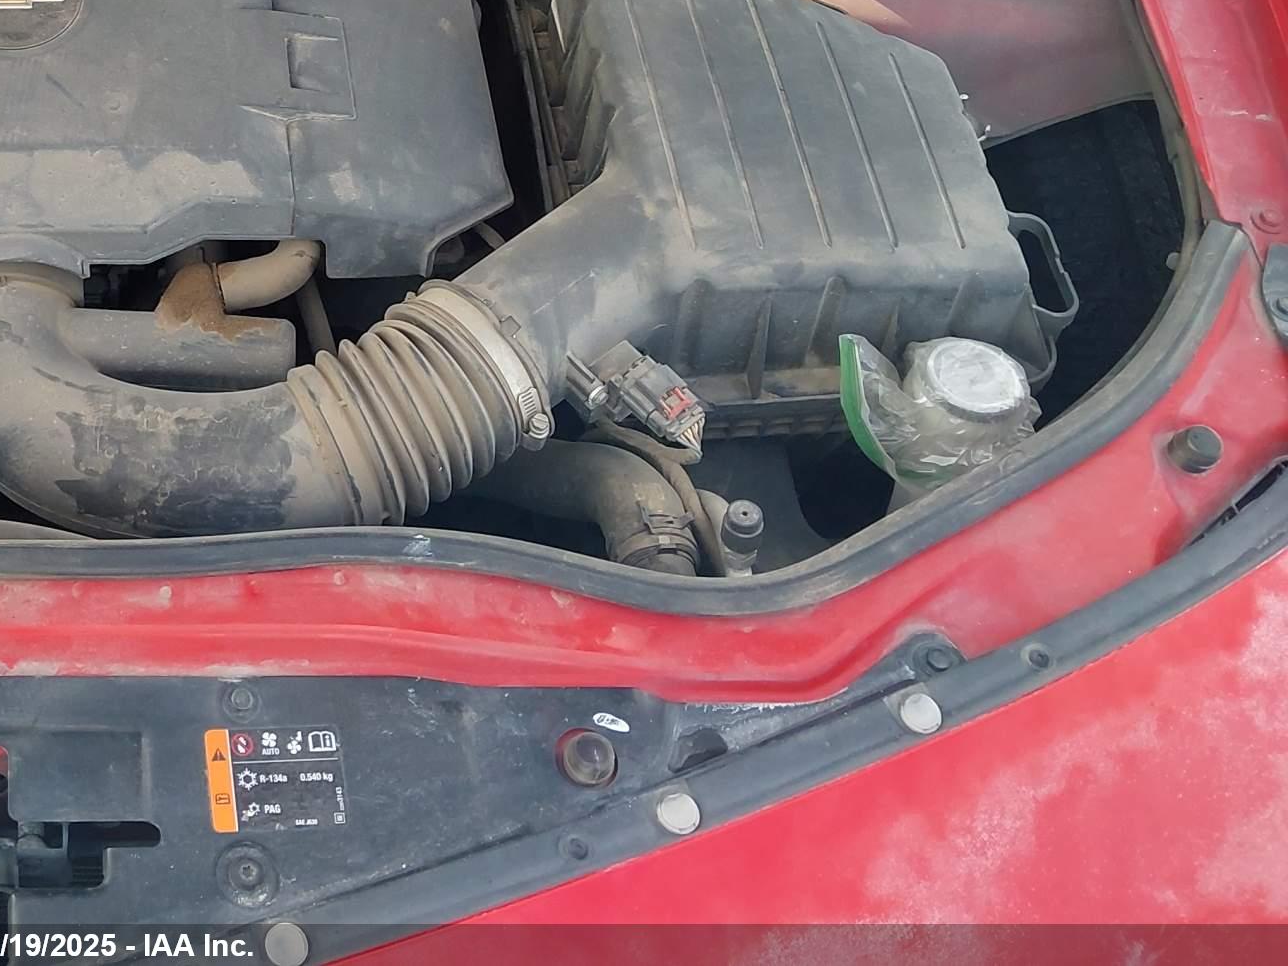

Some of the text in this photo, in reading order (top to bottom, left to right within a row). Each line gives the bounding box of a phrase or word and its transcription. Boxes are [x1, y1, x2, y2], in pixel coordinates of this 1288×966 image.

[261, 748, 280, 756] AUTO
[259, 772, 334, 783] R-134a 0.540 kg
[264, 803, 281, 814] PAG
